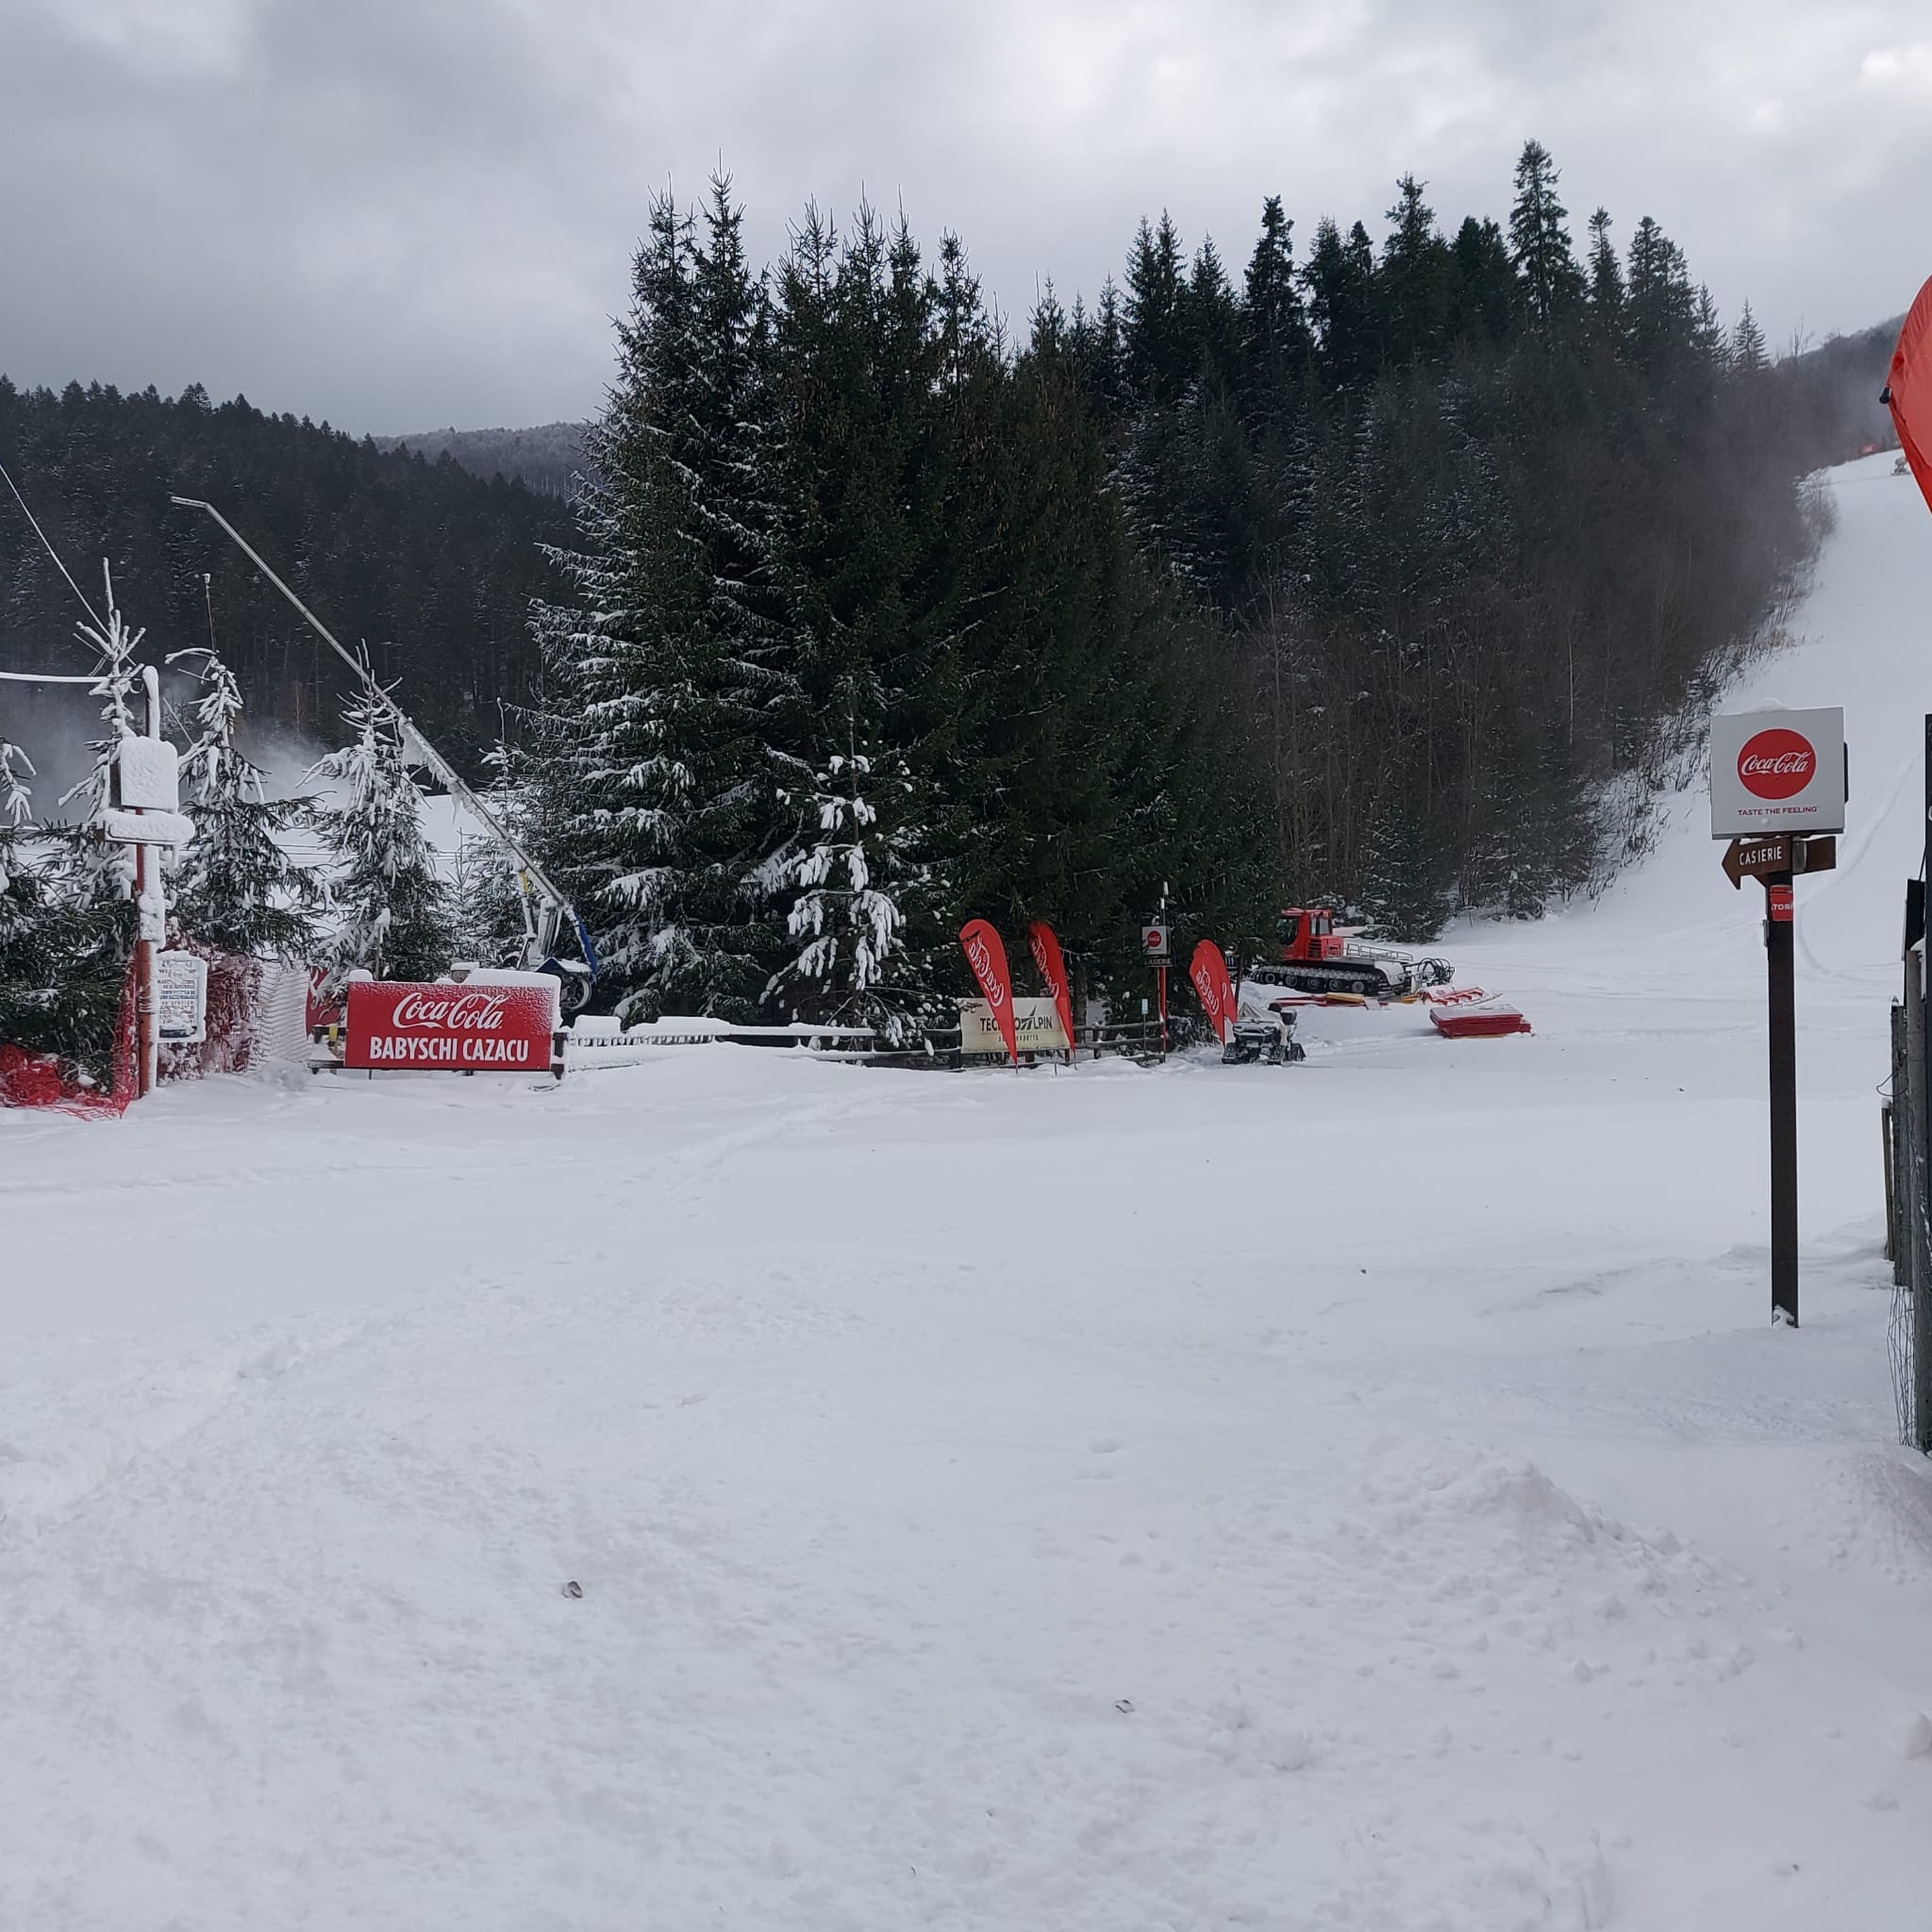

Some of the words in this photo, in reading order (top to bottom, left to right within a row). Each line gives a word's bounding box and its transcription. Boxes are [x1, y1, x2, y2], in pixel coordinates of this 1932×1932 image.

[1741, 752, 1811, 775] Coca-Cola
[1782, 806, 1817, 814] FEELING
[1739, 846, 1782, 865] CASIERIE
[392, 992, 511, 1029] Coca-Cola
[980, 1005, 1053, 1031] TECOALPIN
[369, 1036, 458, 1061] BABYSCHI
[462, 1039, 529, 1062] CAZACU
